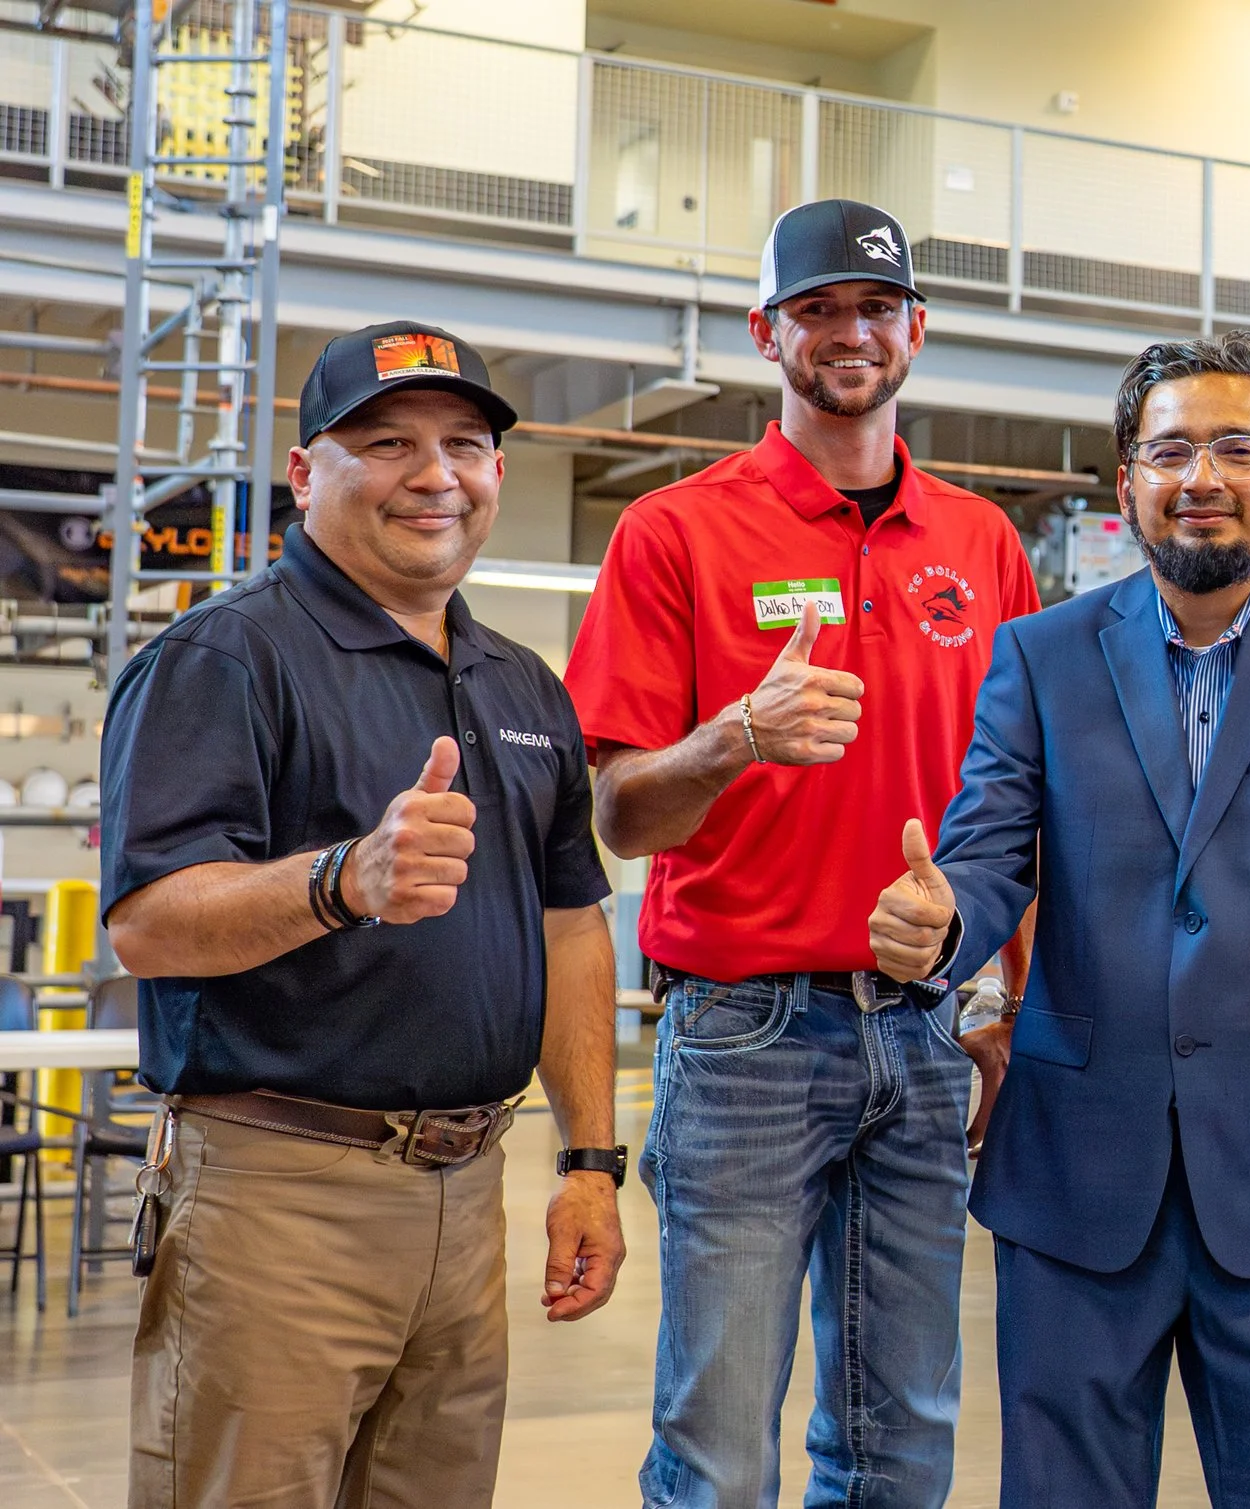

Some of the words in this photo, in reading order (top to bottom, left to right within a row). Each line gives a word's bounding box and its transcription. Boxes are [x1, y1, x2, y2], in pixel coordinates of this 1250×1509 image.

[907, 573, 923, 593] TC
[924, 565, 975, 601] BOILER
[758, 598, 790, 618] Dallas
[931, 626, 974, 648] PIPING
[499, 728, 552, 750] ARKEMA
